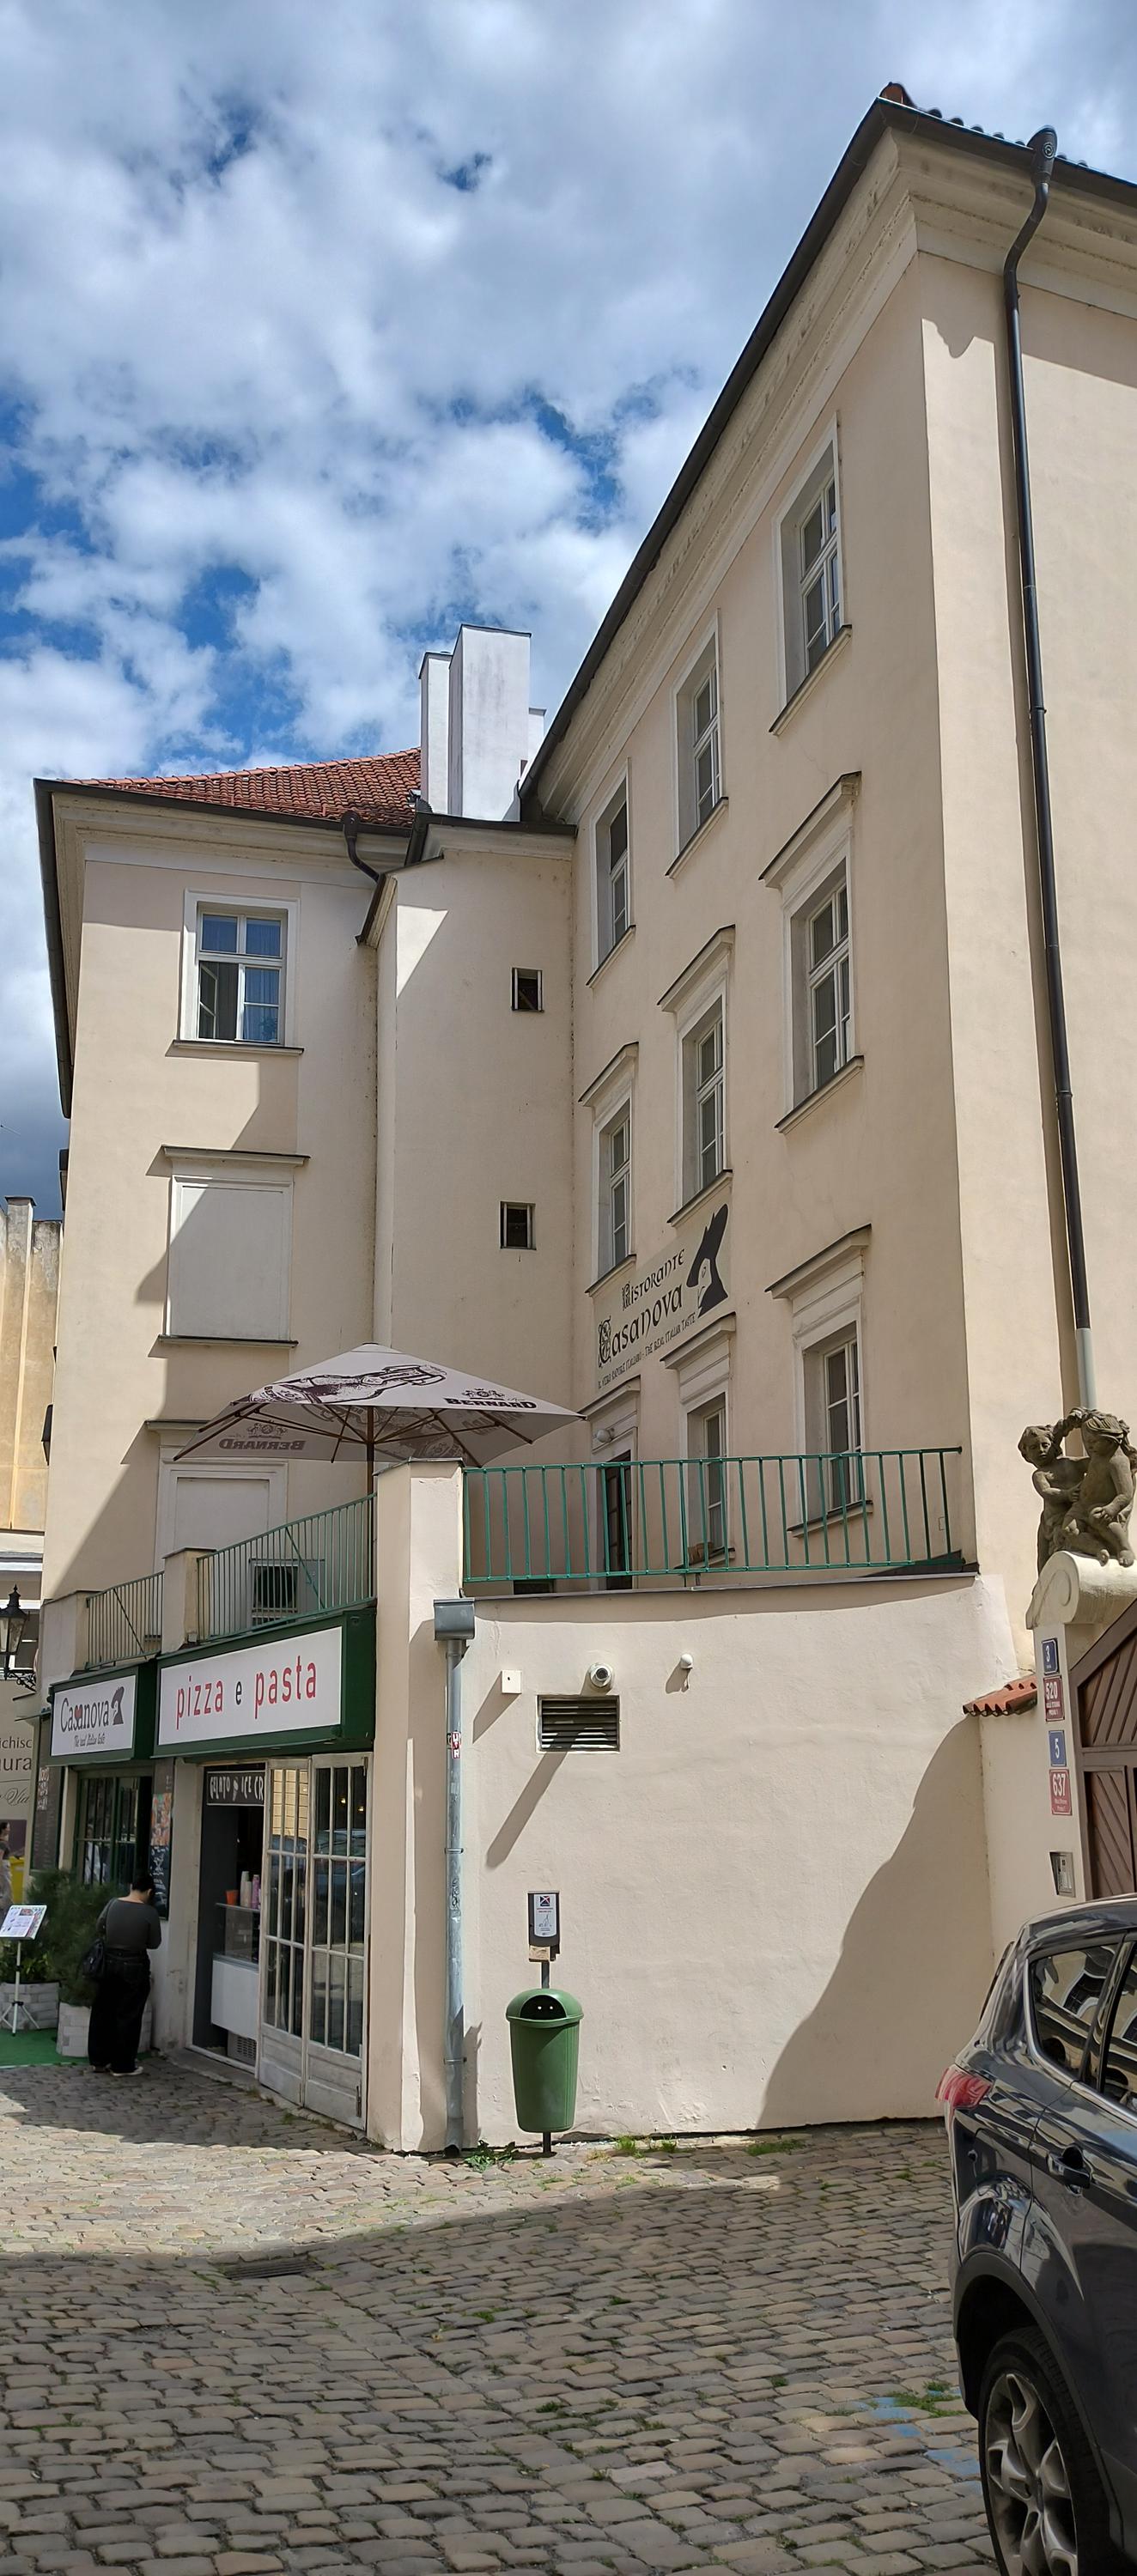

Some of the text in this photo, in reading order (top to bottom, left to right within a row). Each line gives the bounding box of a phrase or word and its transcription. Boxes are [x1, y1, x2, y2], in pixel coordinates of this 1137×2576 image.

[598, 1284, 683, 1368] Casanova
[443, 1397, 538, 1409] BERNARD
[1045, 1644, 1050, 1662] 3
[176, 1656, 317, 1730] pizza e pasta
[1045, 1681, 1058, 1700] 520
[60, 1697, 109, 1733] Casanova
[1055, 1737, 1061, 1759] 5
[0, 1757, 32, 1771] ura
[210, 1776, 230, 1800] GELATO
[240, 1776, 252, 1799] ICE
[1052, 1773, 1067, 1796] 637
